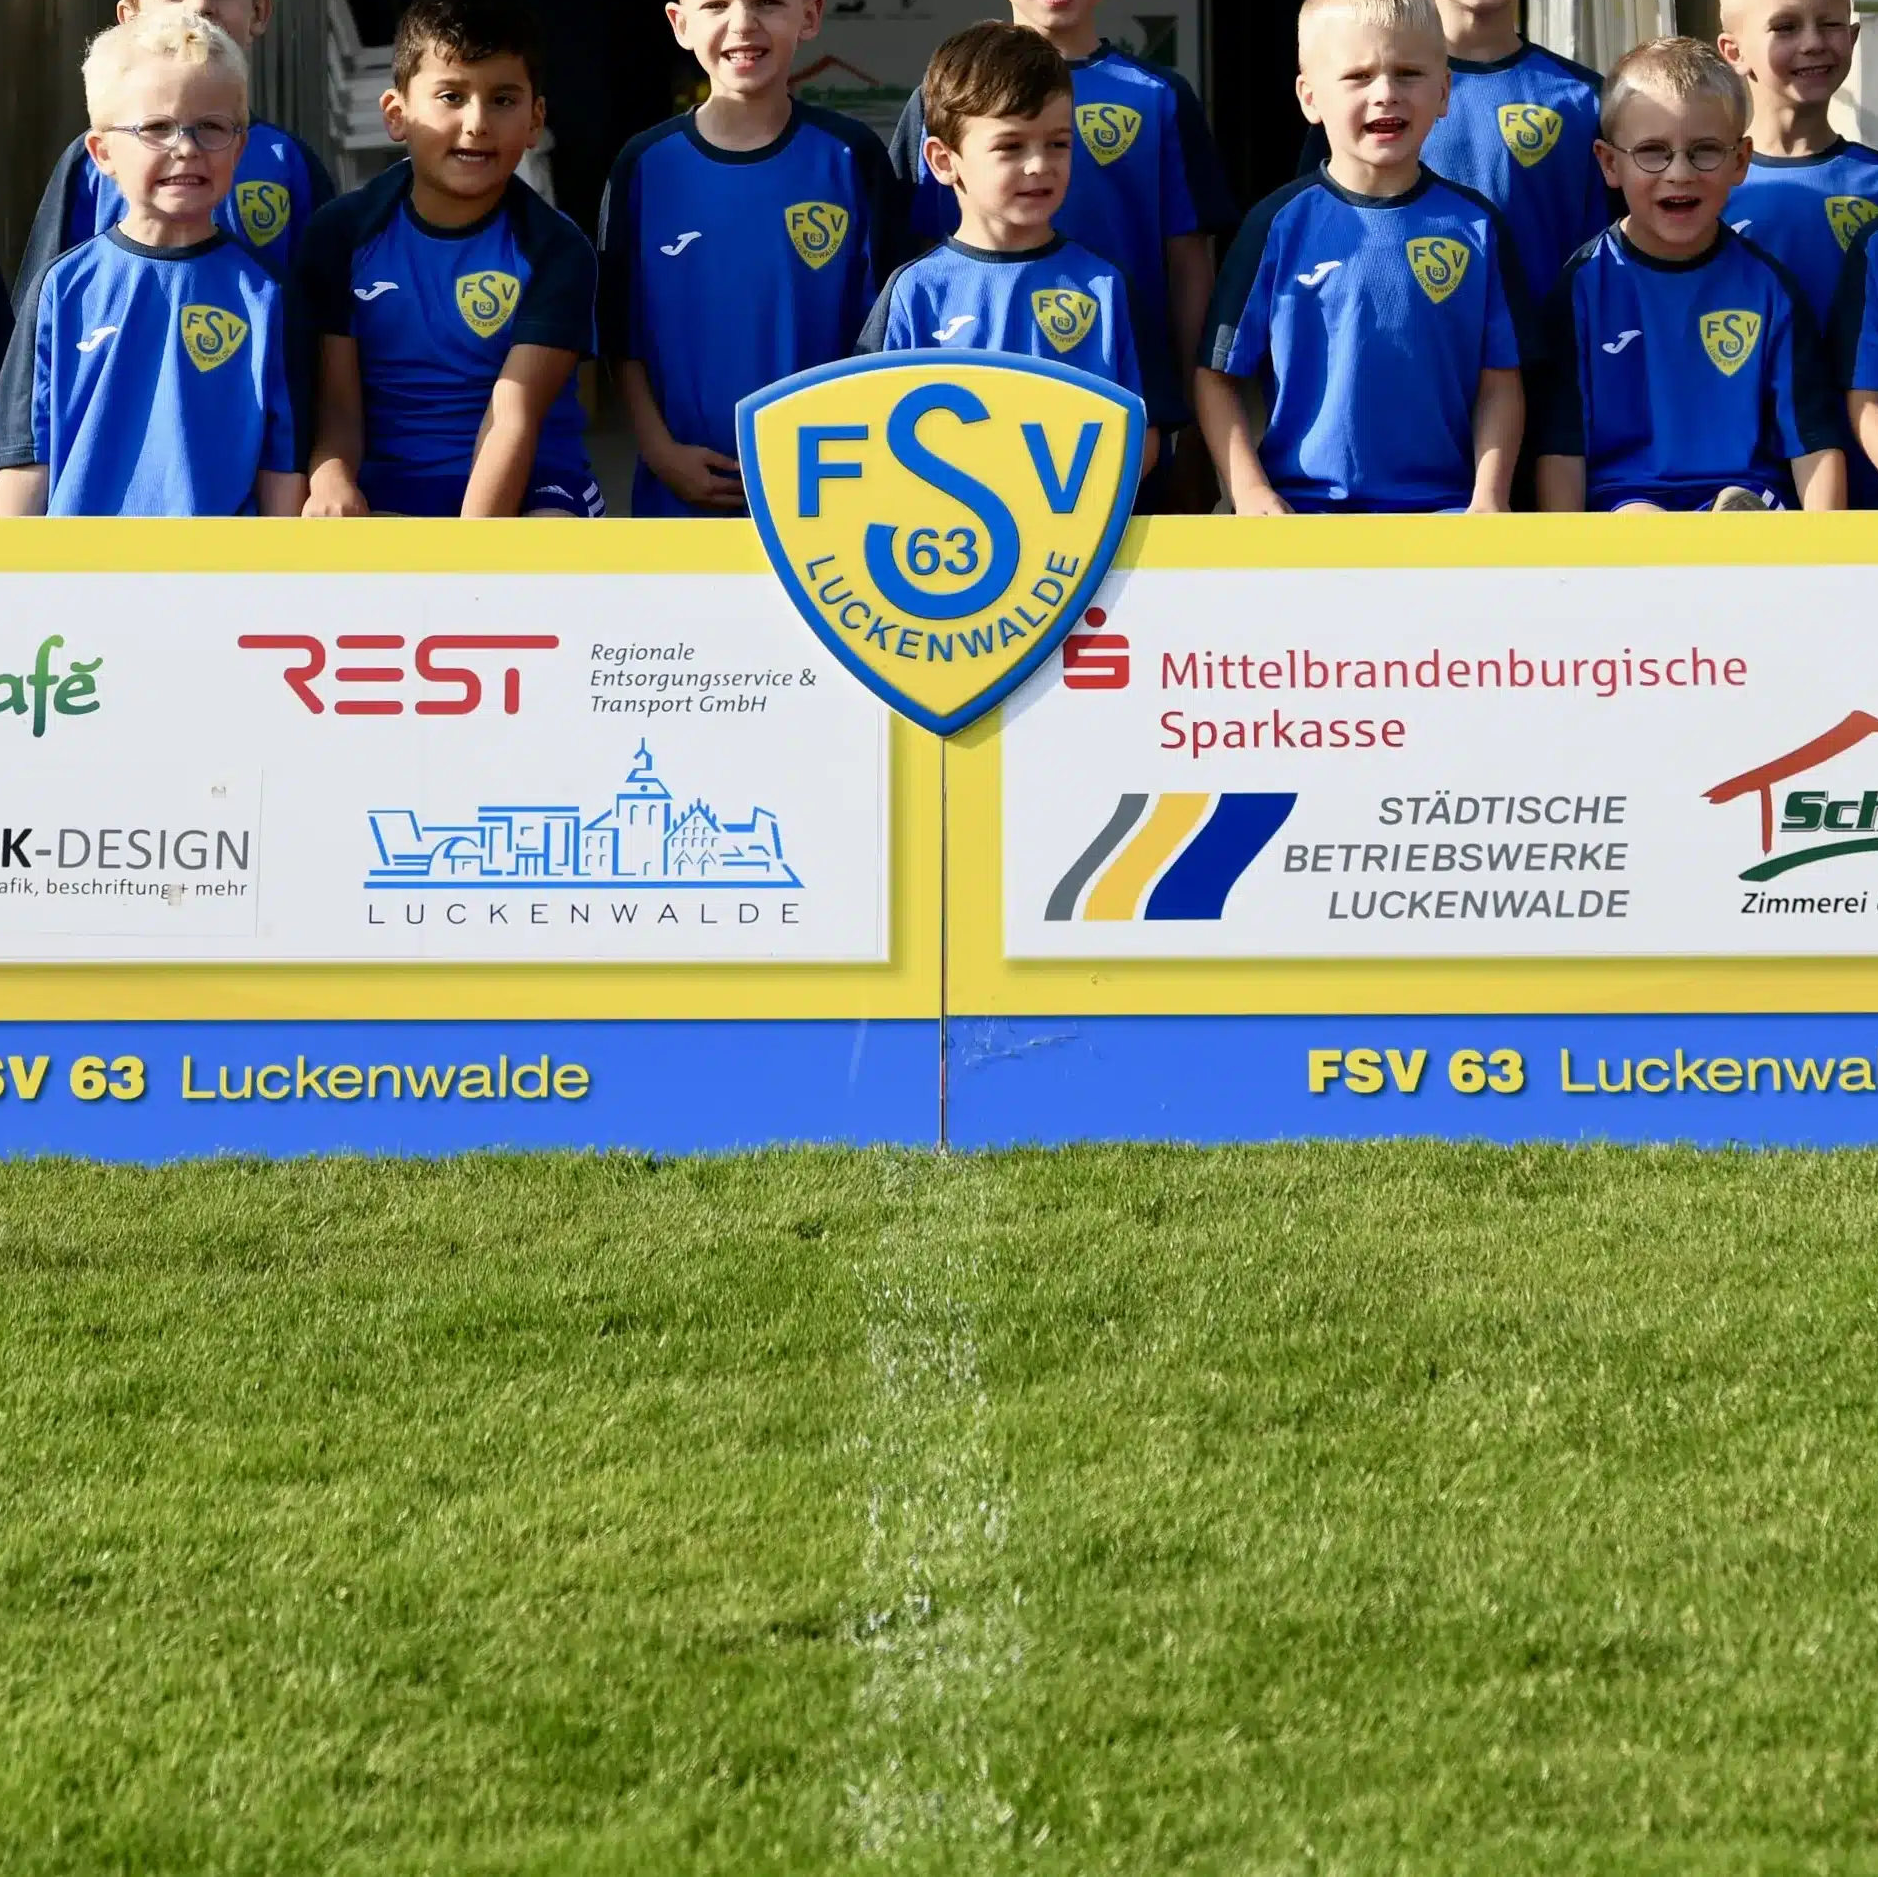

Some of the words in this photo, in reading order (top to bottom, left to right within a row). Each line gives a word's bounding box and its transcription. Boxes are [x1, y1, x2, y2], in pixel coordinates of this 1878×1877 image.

[1083, 107, 1137, 148] FSV
[1505, 109, 1558, 150] FSV
[243, 185, 290, 230] FSV
[792, 205, 844, 252] FSV
[1413, 241, 1465, 286] FSV
[461, 274, 516, 320] FSV
[1038, 293, 1091, 335] FSV
[186, 310, 242, 355] FSV
[1706, 314, 1757, 360] FSV
[797, 381, 1104, 620] FSV
[906, 527, 978, 575] 63
[805, 549, 1081, 663] LUCKENWALDE
[238, 635, 559, 715] REST
[591, 643, 694, 665] Regionale
[1162, 647, 1747, 697] Mittelbrandenburgische
[591, 670, 792, 692] Entsorgungsservice
[800, 669, 816, 686] &
[592, 696, 693, 717] Transport
[700, 695, 766, 712] GmbH
[1161, 709, 1405, 759] Sparkasse
[1379, 791, 1627, 825] STÄDTISCHE
[1284, 843, 1628, 872] BETRIEBSWERKE
[47, 878, 169, 899] beschriftung
[196, 880, 247, 896] mehr
[1329, 890, 1630, 919] LUCKENWALDE
[1741, 892, 1867, 913] Zimmerei
[369, 904, 799, 924] LUCKENWALDE
[70, 1055, 147, 1102] 63
[182, 1054, 591, 1102] Luckenwalde
[1308, 1048, 1429, 1096] FSV
[1449, 1049, 1527, 1095] 63
